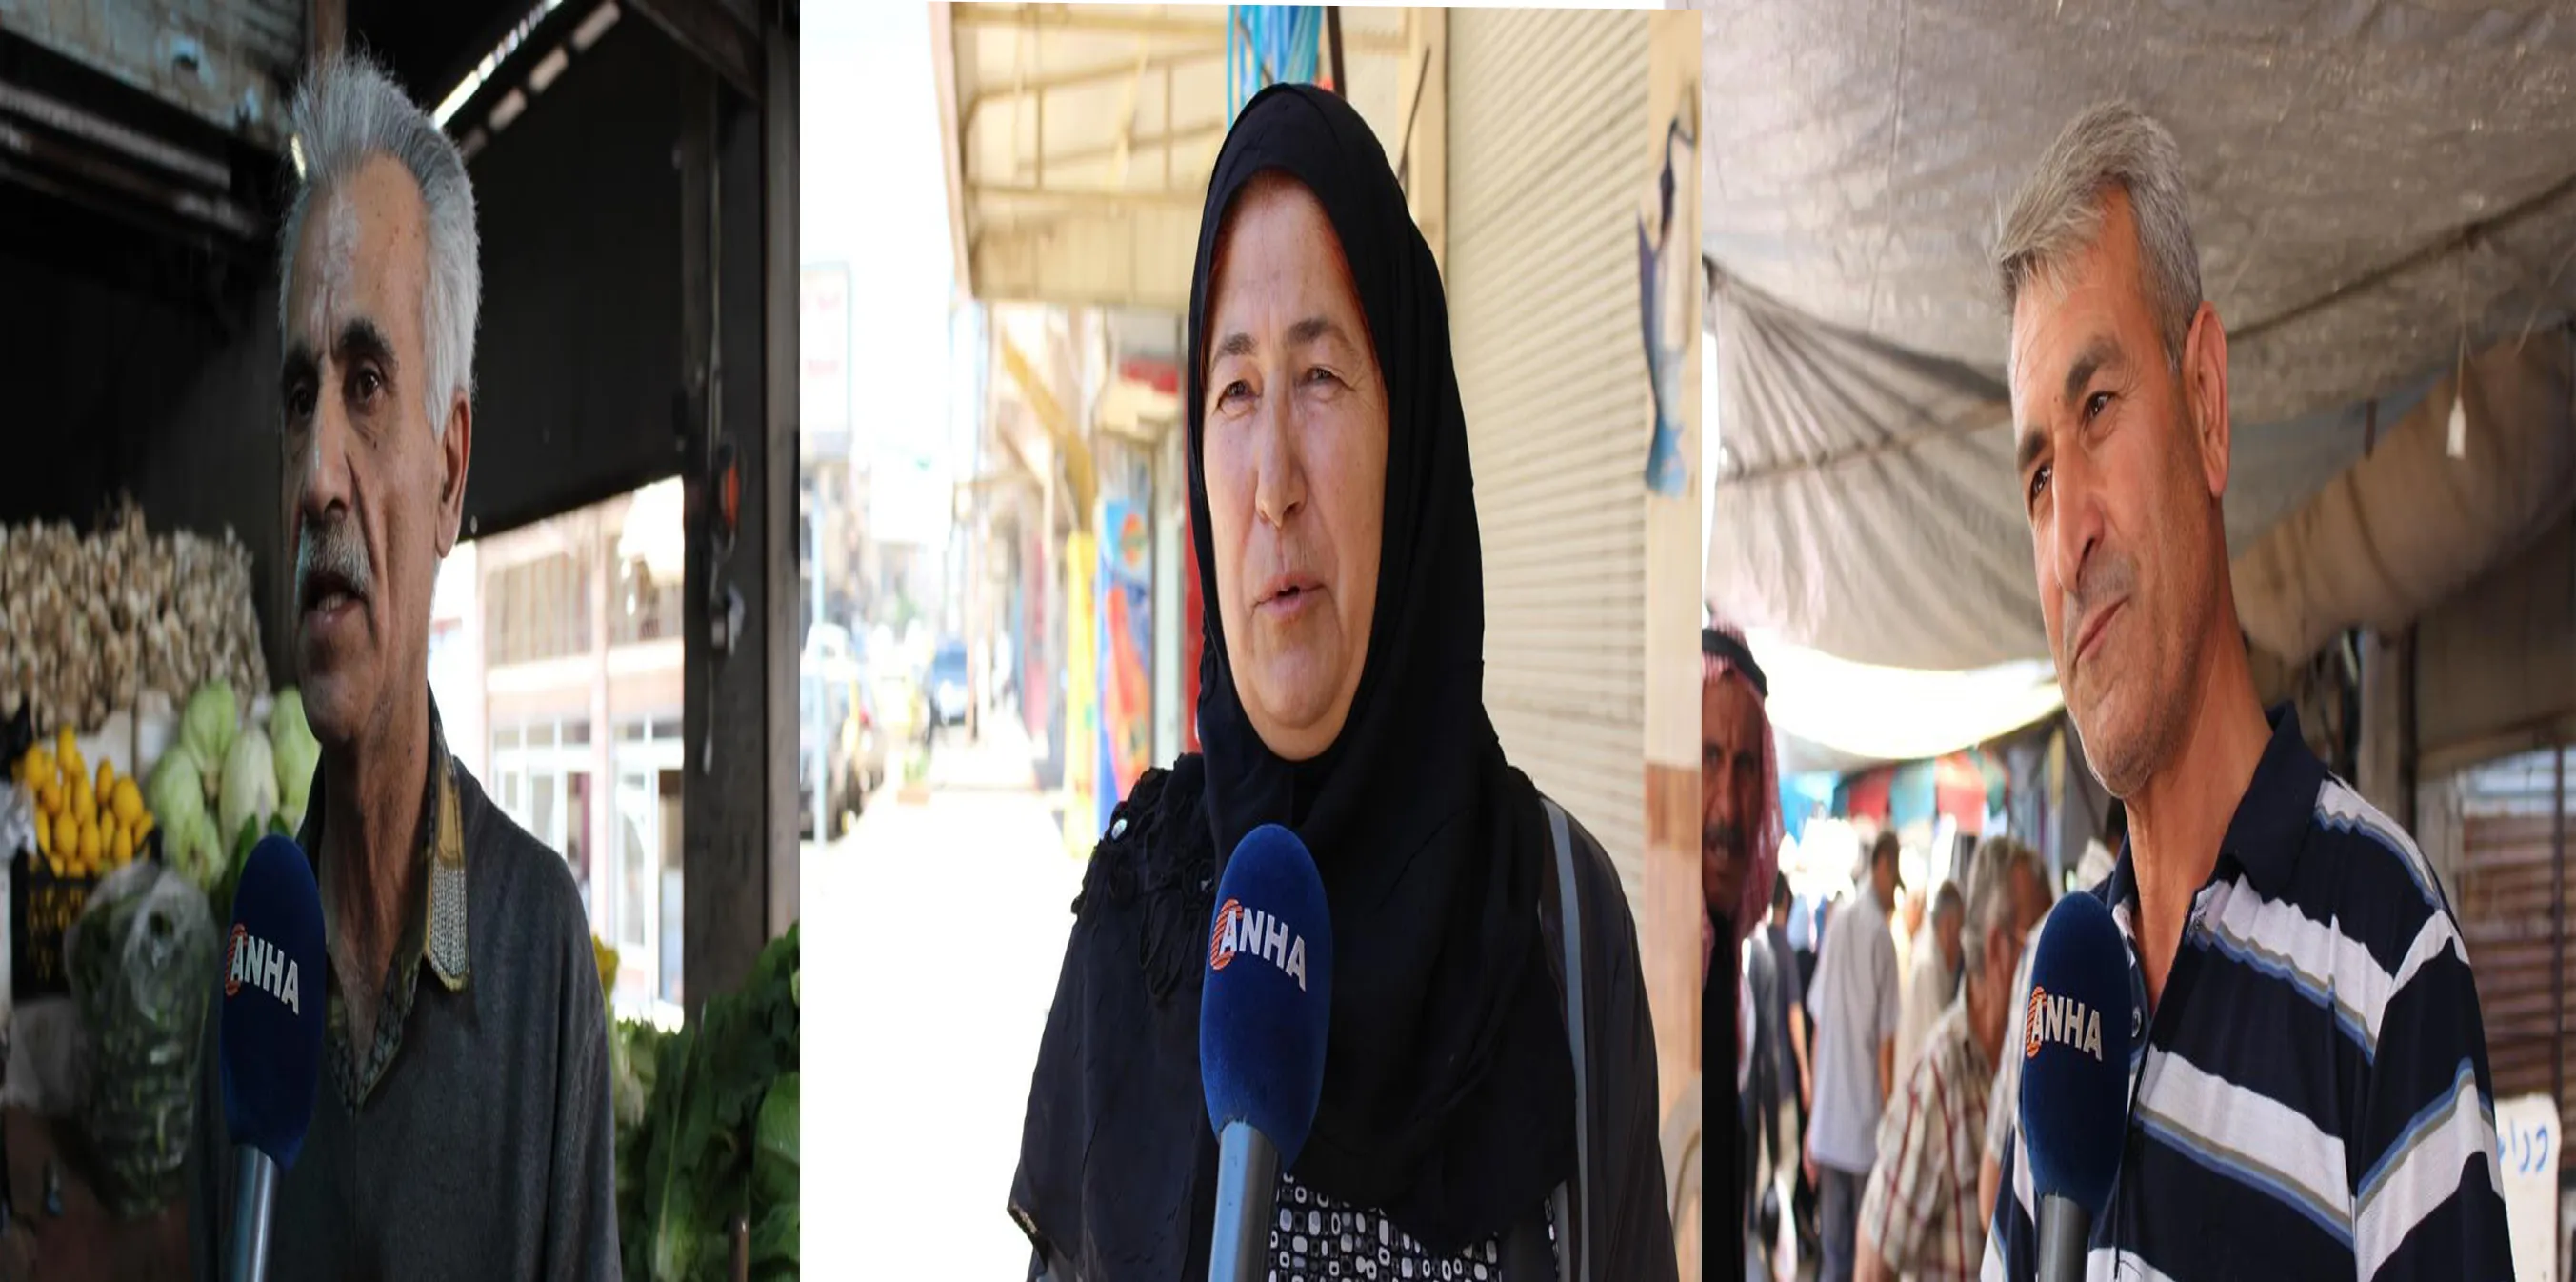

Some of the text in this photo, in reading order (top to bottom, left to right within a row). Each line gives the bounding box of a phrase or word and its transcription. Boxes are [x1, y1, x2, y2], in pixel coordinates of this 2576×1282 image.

[230, 935, 299, 1016] ANHA
[1219, 907, 1306, 992] ANHA
[2031, 994, 2103, 1062] ANHA
